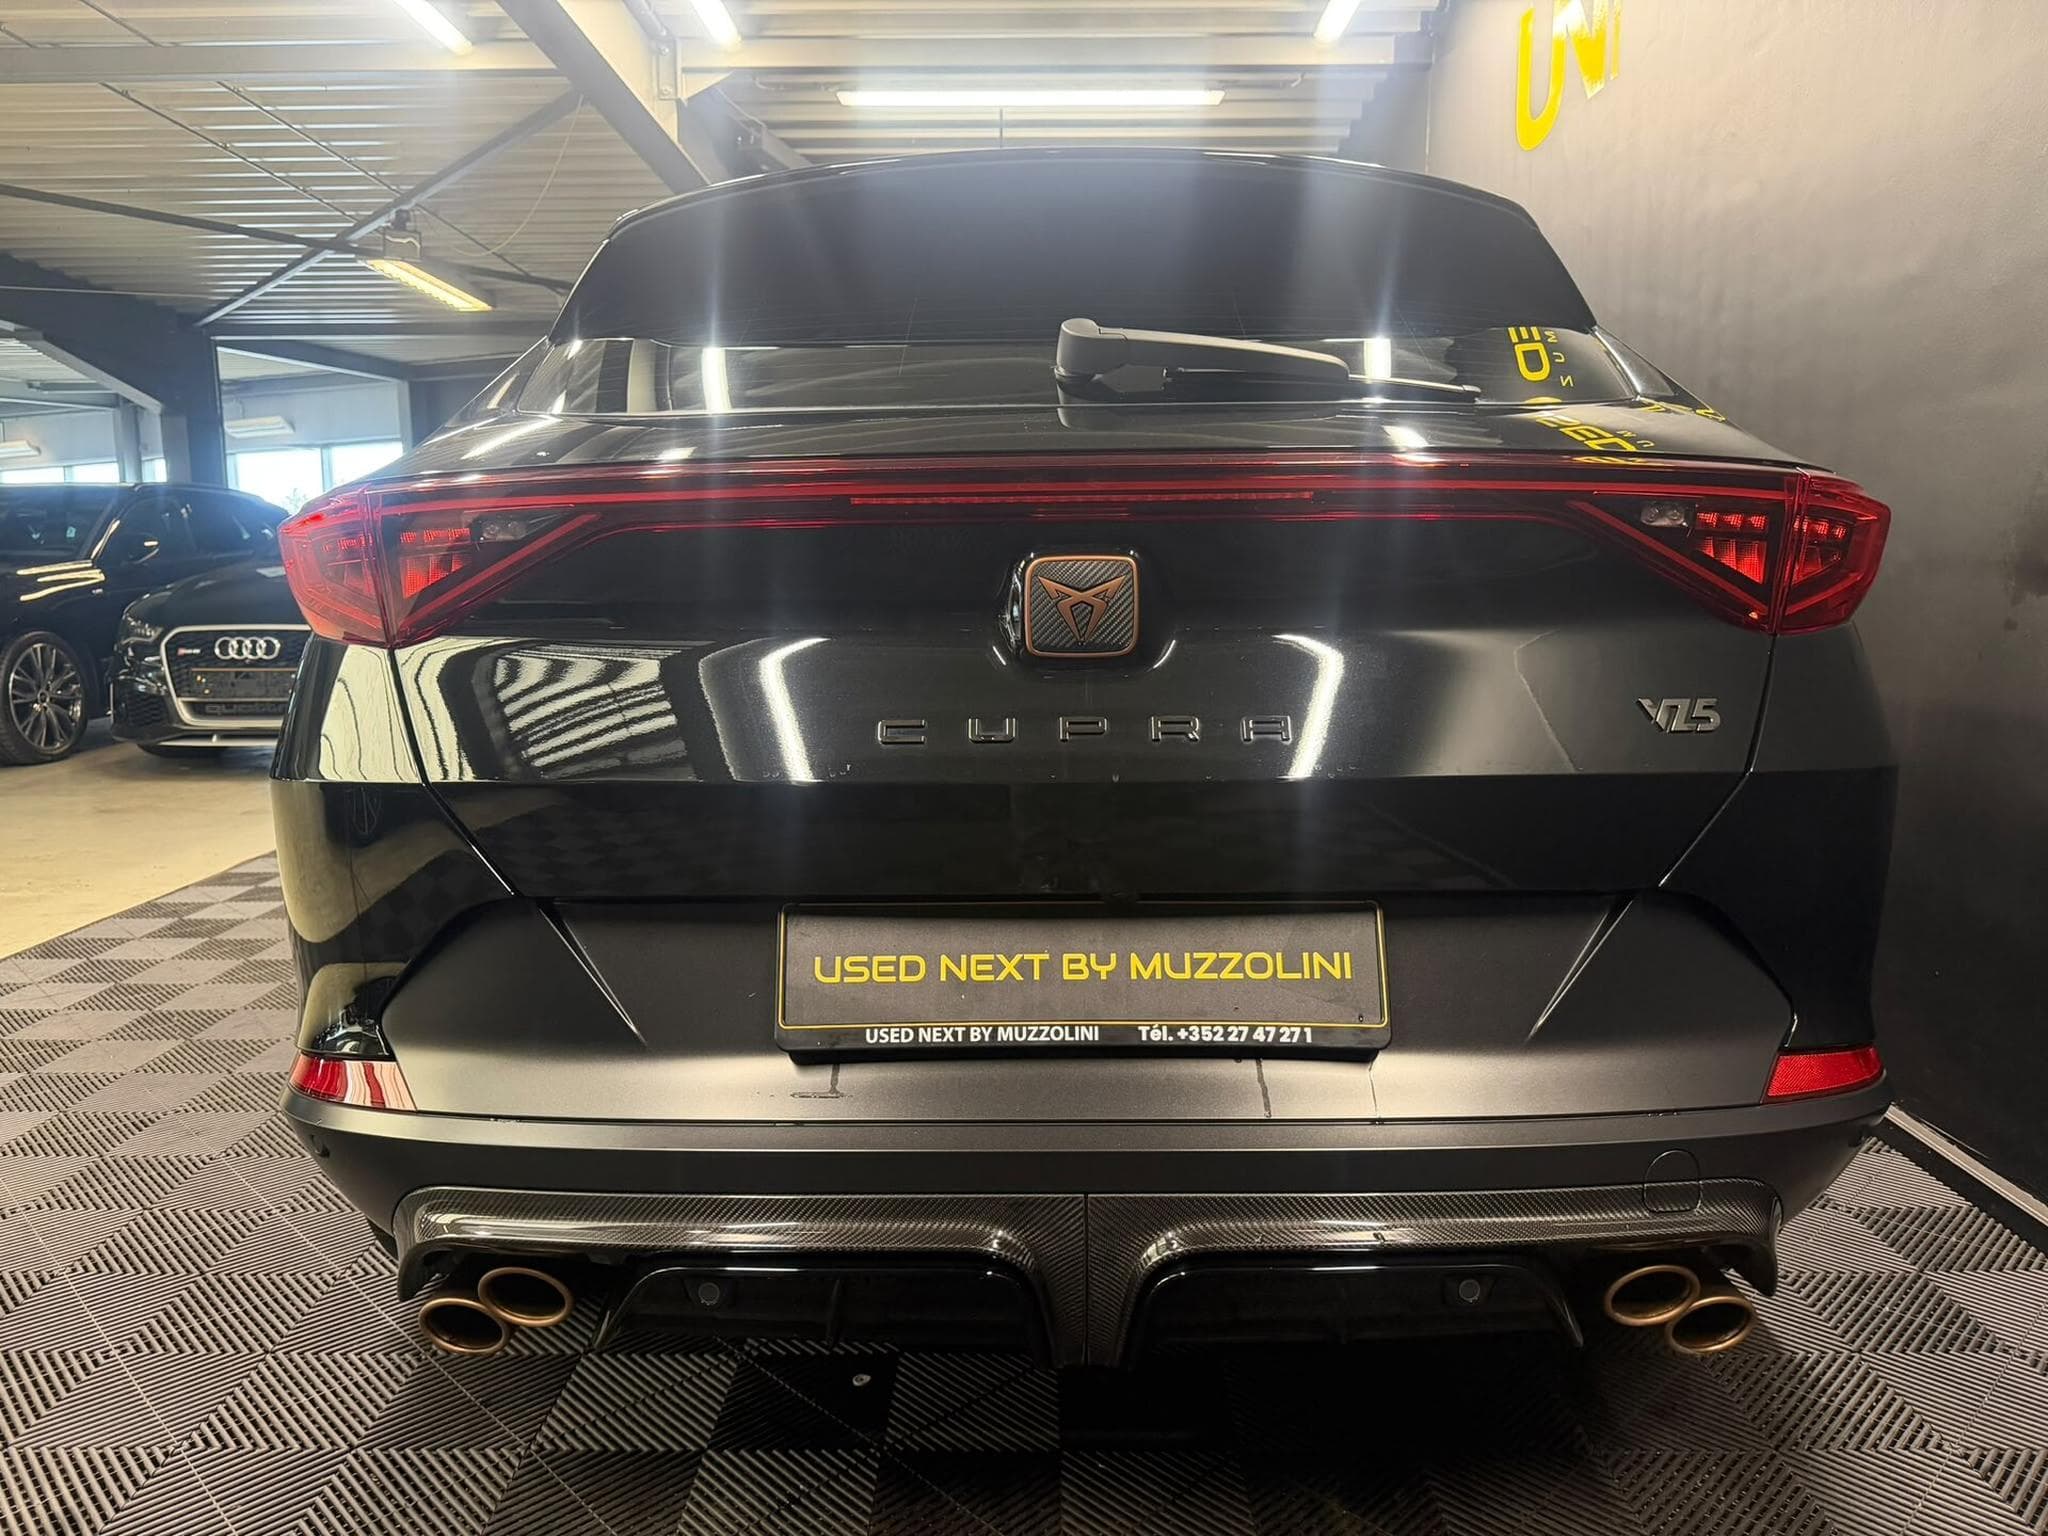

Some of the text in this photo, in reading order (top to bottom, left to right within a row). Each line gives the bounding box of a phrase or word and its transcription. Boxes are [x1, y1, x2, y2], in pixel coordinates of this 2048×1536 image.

[876, 715, 1293, 745] CUPRA
[814, 951, 1353, 984] USED NEXT BY MUZZOLINI
[865, 1028, 914, 1044] USED
[917, 1027, 966, 1043] NEXT
[970, 1026, 993, 1042] BY
[997, 1026, 1099, 1042] MUZZOLINI
[1137, 1024, 1174, 1042] Tél.
[1176, 1026, 1224, 1042] +352
[1226, 1027, 1249, 1042] 27
[1252, 1027, 1278, 1043] 47
